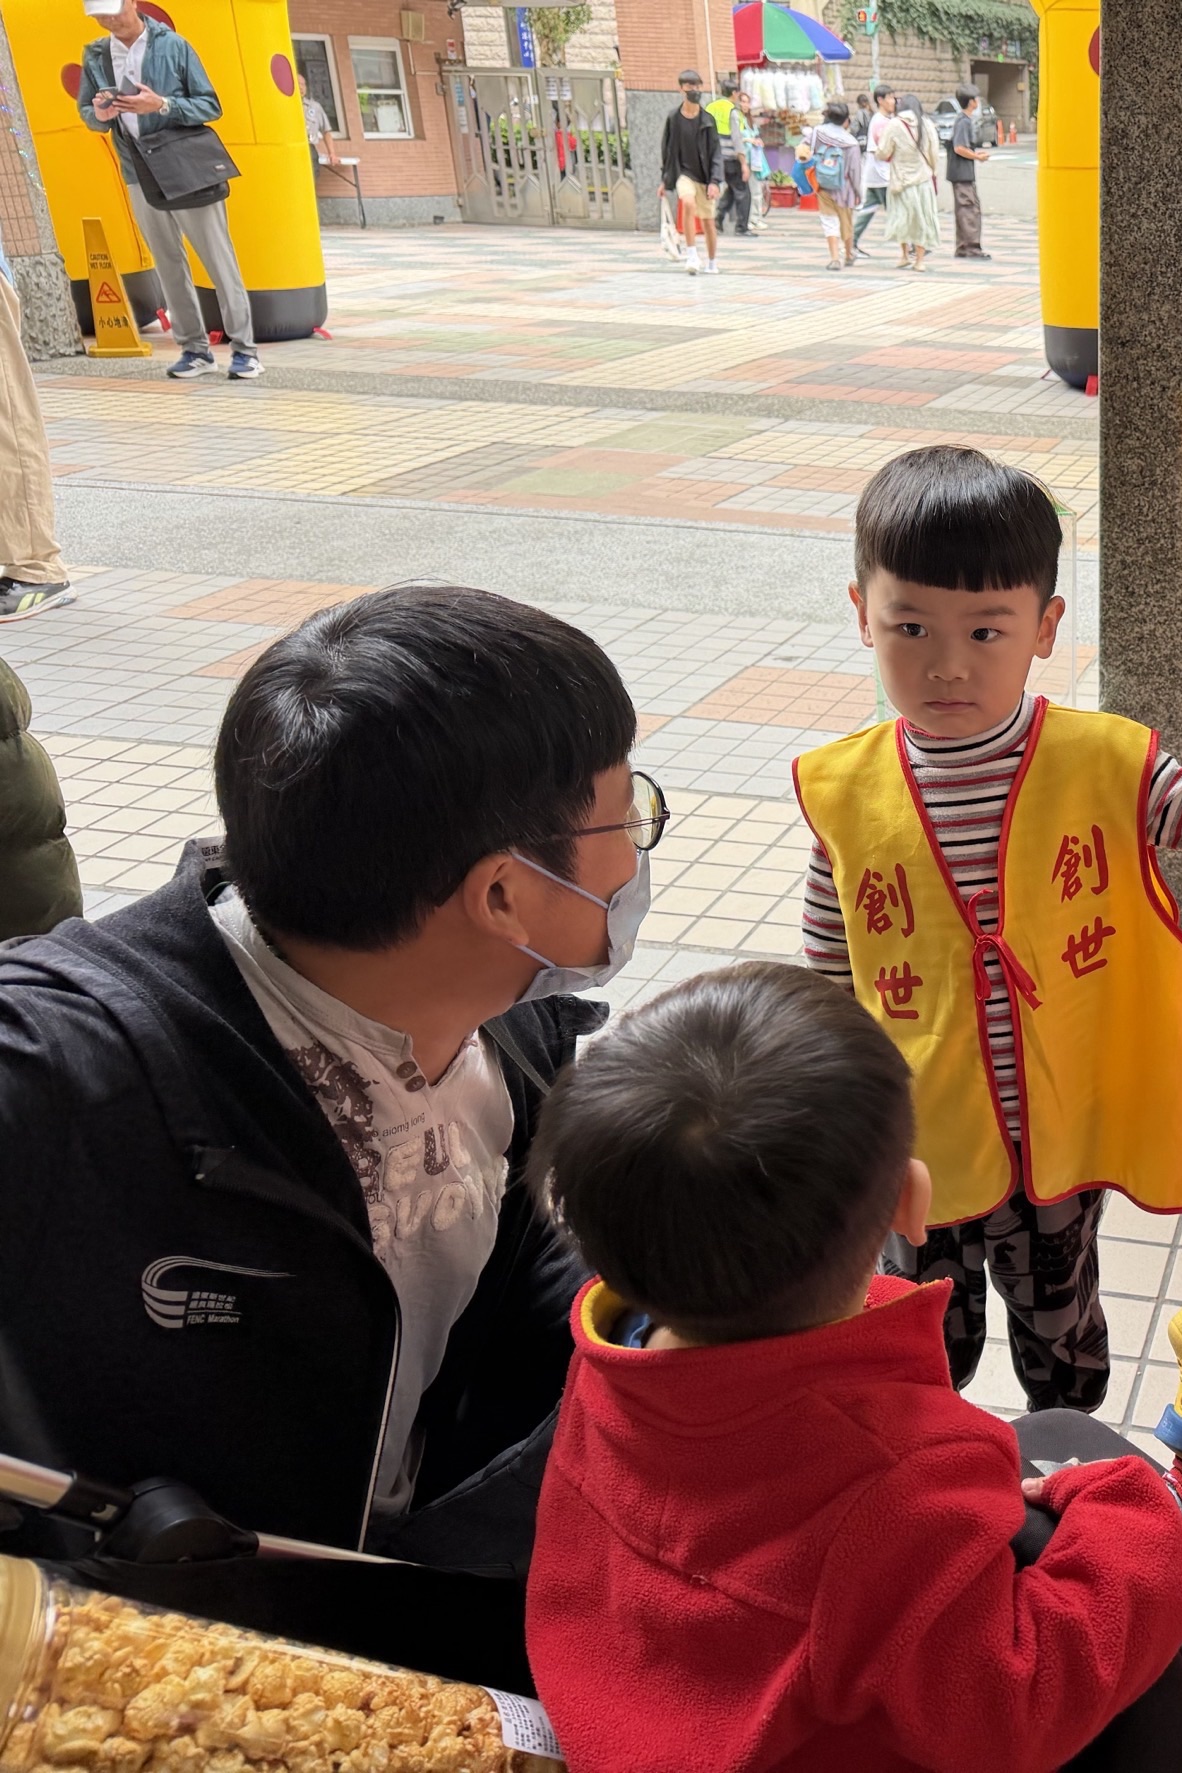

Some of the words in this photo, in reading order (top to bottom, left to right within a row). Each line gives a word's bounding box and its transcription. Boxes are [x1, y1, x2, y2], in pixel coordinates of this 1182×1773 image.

[854, 862, 924, 1021] 創世
[1051, 824, 1117, 979] 創世
[207, 1313, 240, 1324] Marathon
